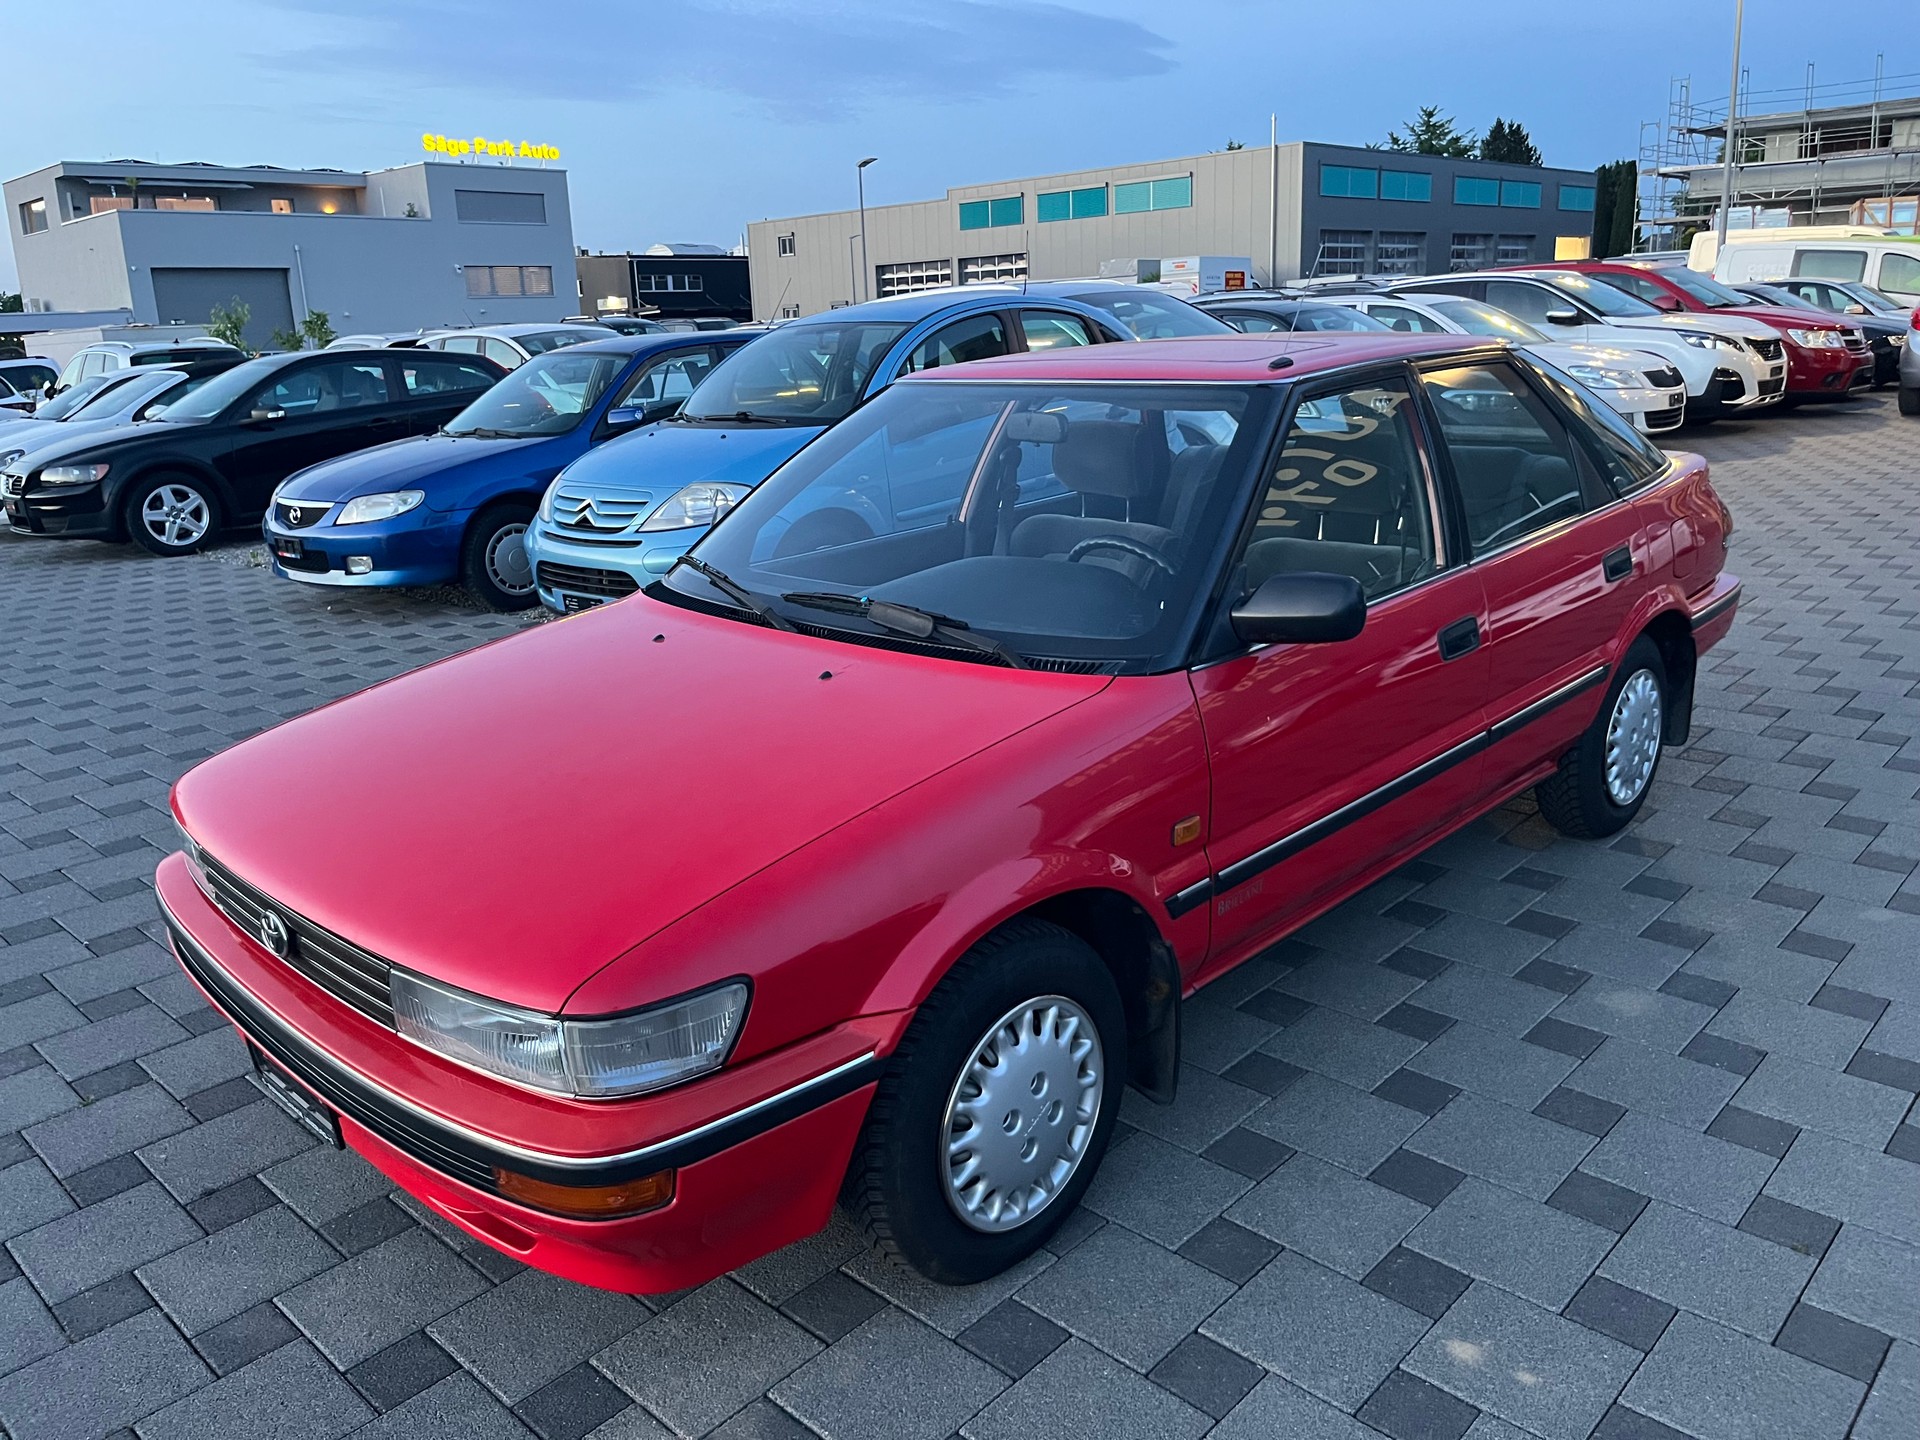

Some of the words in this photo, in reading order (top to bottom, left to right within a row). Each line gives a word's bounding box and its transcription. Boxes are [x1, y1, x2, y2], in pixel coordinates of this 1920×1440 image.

[422, 133, 470, 157] Säge
[473, 137, 515, 156] Park
[519, 140, 560, 160] Auto
